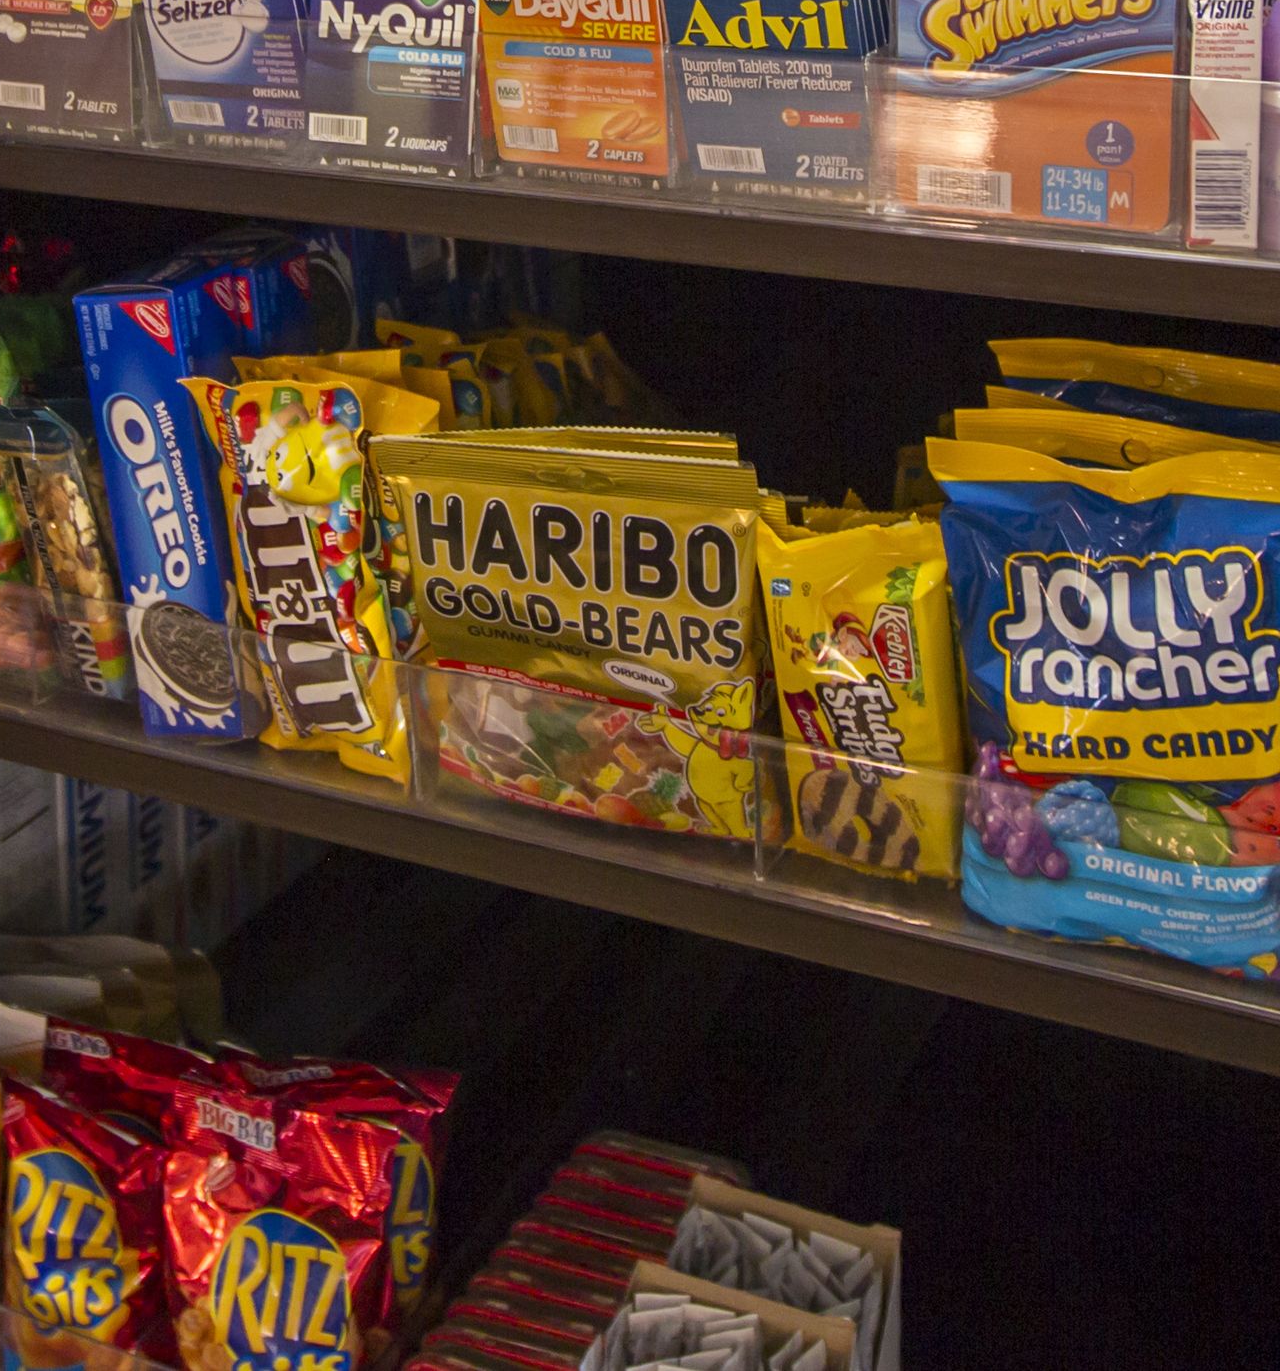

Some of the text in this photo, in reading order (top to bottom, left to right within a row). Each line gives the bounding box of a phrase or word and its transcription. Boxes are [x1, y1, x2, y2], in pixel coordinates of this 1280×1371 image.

[12, 0, 44, 10] WONDER
[318, 0, 466, 54] NyQuil
[581, 22, 656, 42] SEVERE
[1195, 21, 1249, 31] ORIGINAL
[398, 50, 463, 65] COLD & FLU
[543, 45, 612, 60] COLD & FLU
[681, 57, 833, 79] Ibuprofen Tablets, 200 mg
[252, 87, 302, 100] ORIGINAL
[497, 85, 521, 98] MAX
[684, 73, 853, 93] Pain Reliever/ Fever Reducer
[63, 90, 118, 115] 2 TABLETS
[686, 87, 734, 106] (NSAID)
[246, 105, 260, 128] 2
[263, 116, 305, 130] TABLETS
[808, 114, 845, 125] Tablets
[384, 125, 448, 153] 2 LIQUICAPS
[1104, 122, 1116, 144] 1
[586, 139, 644, 163] 2 CAPLETS
[1095, 141, 1123, 157] pant
[795, 154, 811, 179] 2
[813, 155, 849, 168] COATED
[812, 167, 865, 181] TABLETS
[1046, 169, 1093, 191] 24-34
[1045, 190, 1103, 219] 11-15 kg
[1110, 190, 1130, 210] M
[110, 393, 191, 589] OREO
[152, 399, 208, 567] Milk's Favorite Cookie
[413, 491, 740, 609] HARIBO
[1004, 561, 1248, 650] JOLLY
[424, 576, 744, 670] GOLD-BEARS
[466, 623, 592, 660] GUMMI CANDY
[877, 604, 907, 683] Keebler
[69, 621, 108, 696] KIND
[609, 664, 671, 689] ORIGINAL
[1018, 642, 1278, 702] rancher
[852, 677, 902, 779] Fudge
[1022, 723, 1280, 762] HARD CANDY
[1084, 854, 1185, 888] ORIGINAL
[1084, 890, 1124, 907] GREEN
[196, 1098, 276, 1152] BIG BAG
[215, 1225, 347, 1355] RITZ
